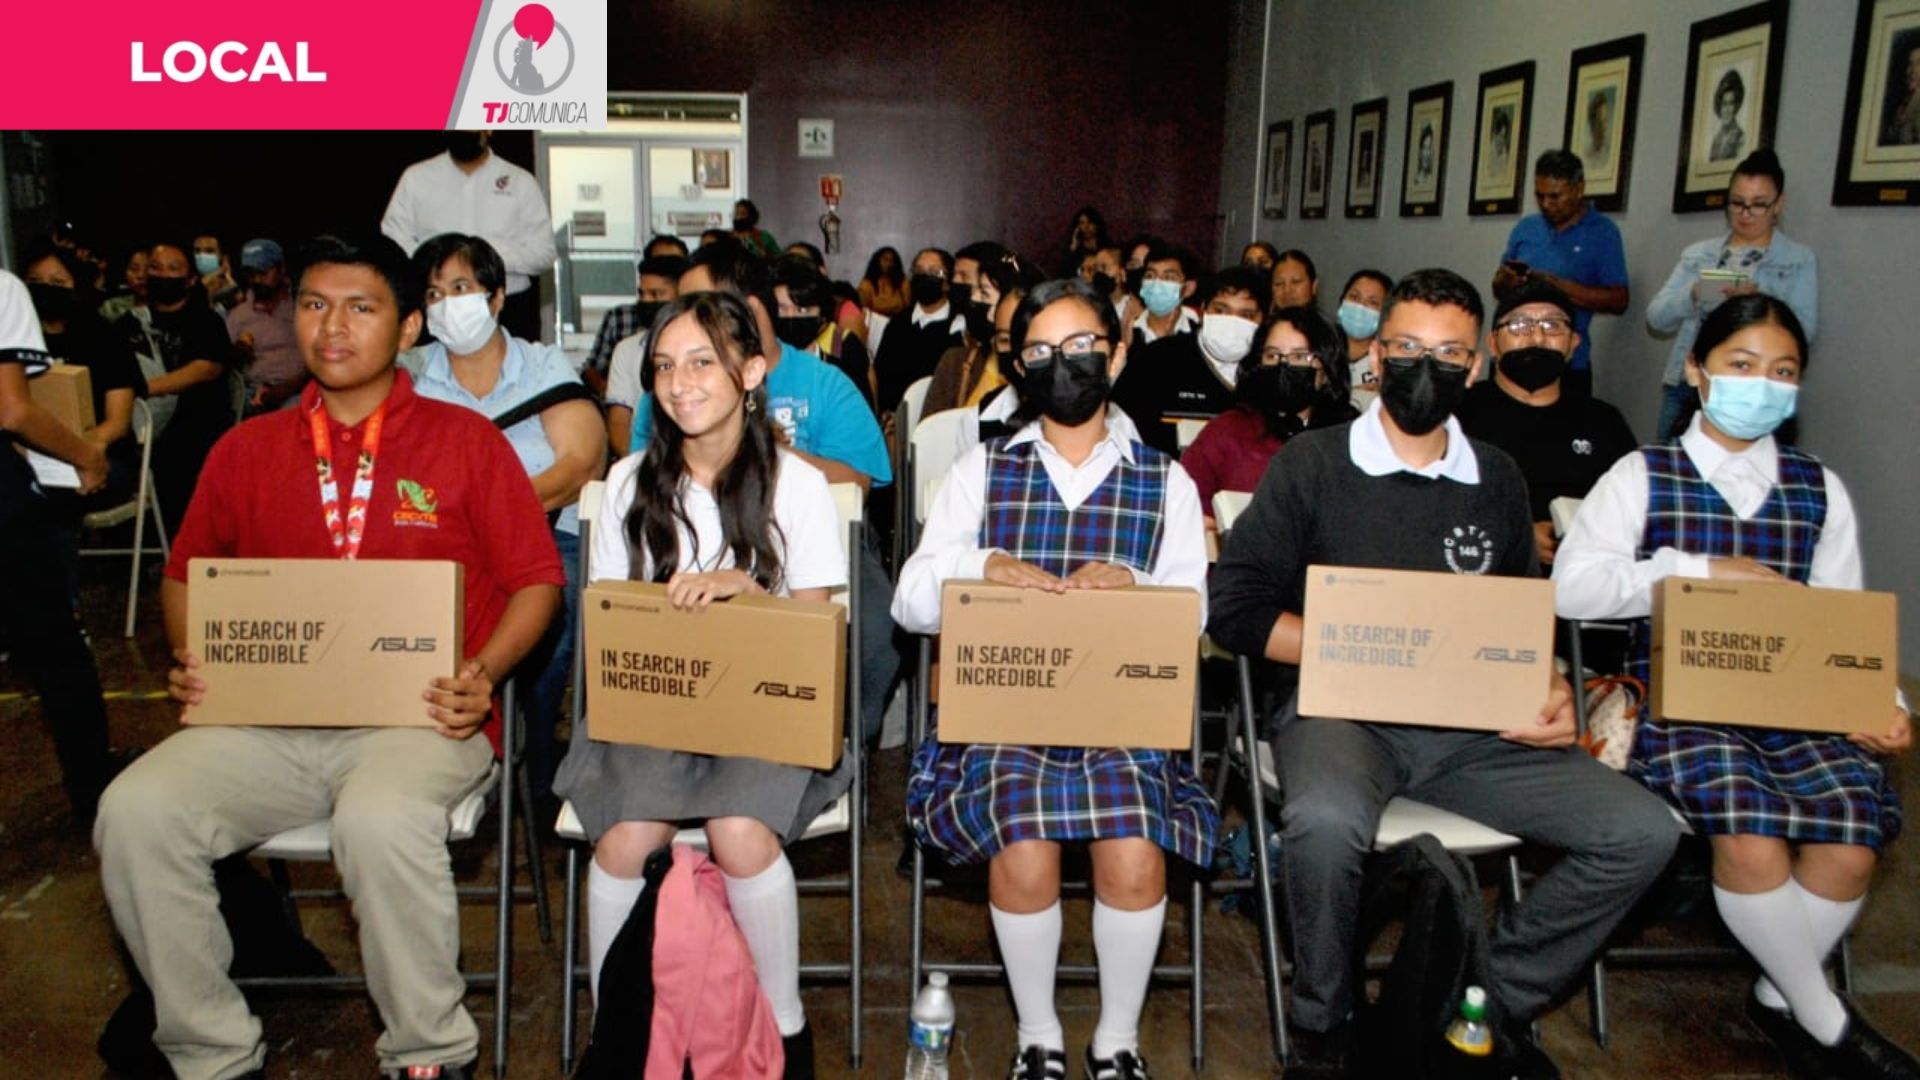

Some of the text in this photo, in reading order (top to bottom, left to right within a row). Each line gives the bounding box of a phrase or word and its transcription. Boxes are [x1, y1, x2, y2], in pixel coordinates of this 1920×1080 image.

[205, 621, 325, 641] IN SEARCH OF
[1320, 623, 1433, 647] IN SEARCH OF
[1680, 629, 1786, 654] IN SEARCH OF
[205, 643, 309, 664] INCREDIBLE
[370, 637, 437, 652] ASUS
[1473, 646, 1537, 664] ASUS
[601, 649, 712, 678] IN SEARCH OF
[957, 645, 1073, 666] IN SEARCH OF
[1319, 645, 1417, 668] INCREDIBLE
[1680, 648, 1773, 673] INCREDIBLE
[1824, 653, 1883, 671] ASUS
[956, 666, 1057, 688] INCREDIBLE
[1115, 664, 1179, 680] ASUS
[601, 670, 697, 698] INCREDIBLE
[753, 681, 816, 701] ASUS
